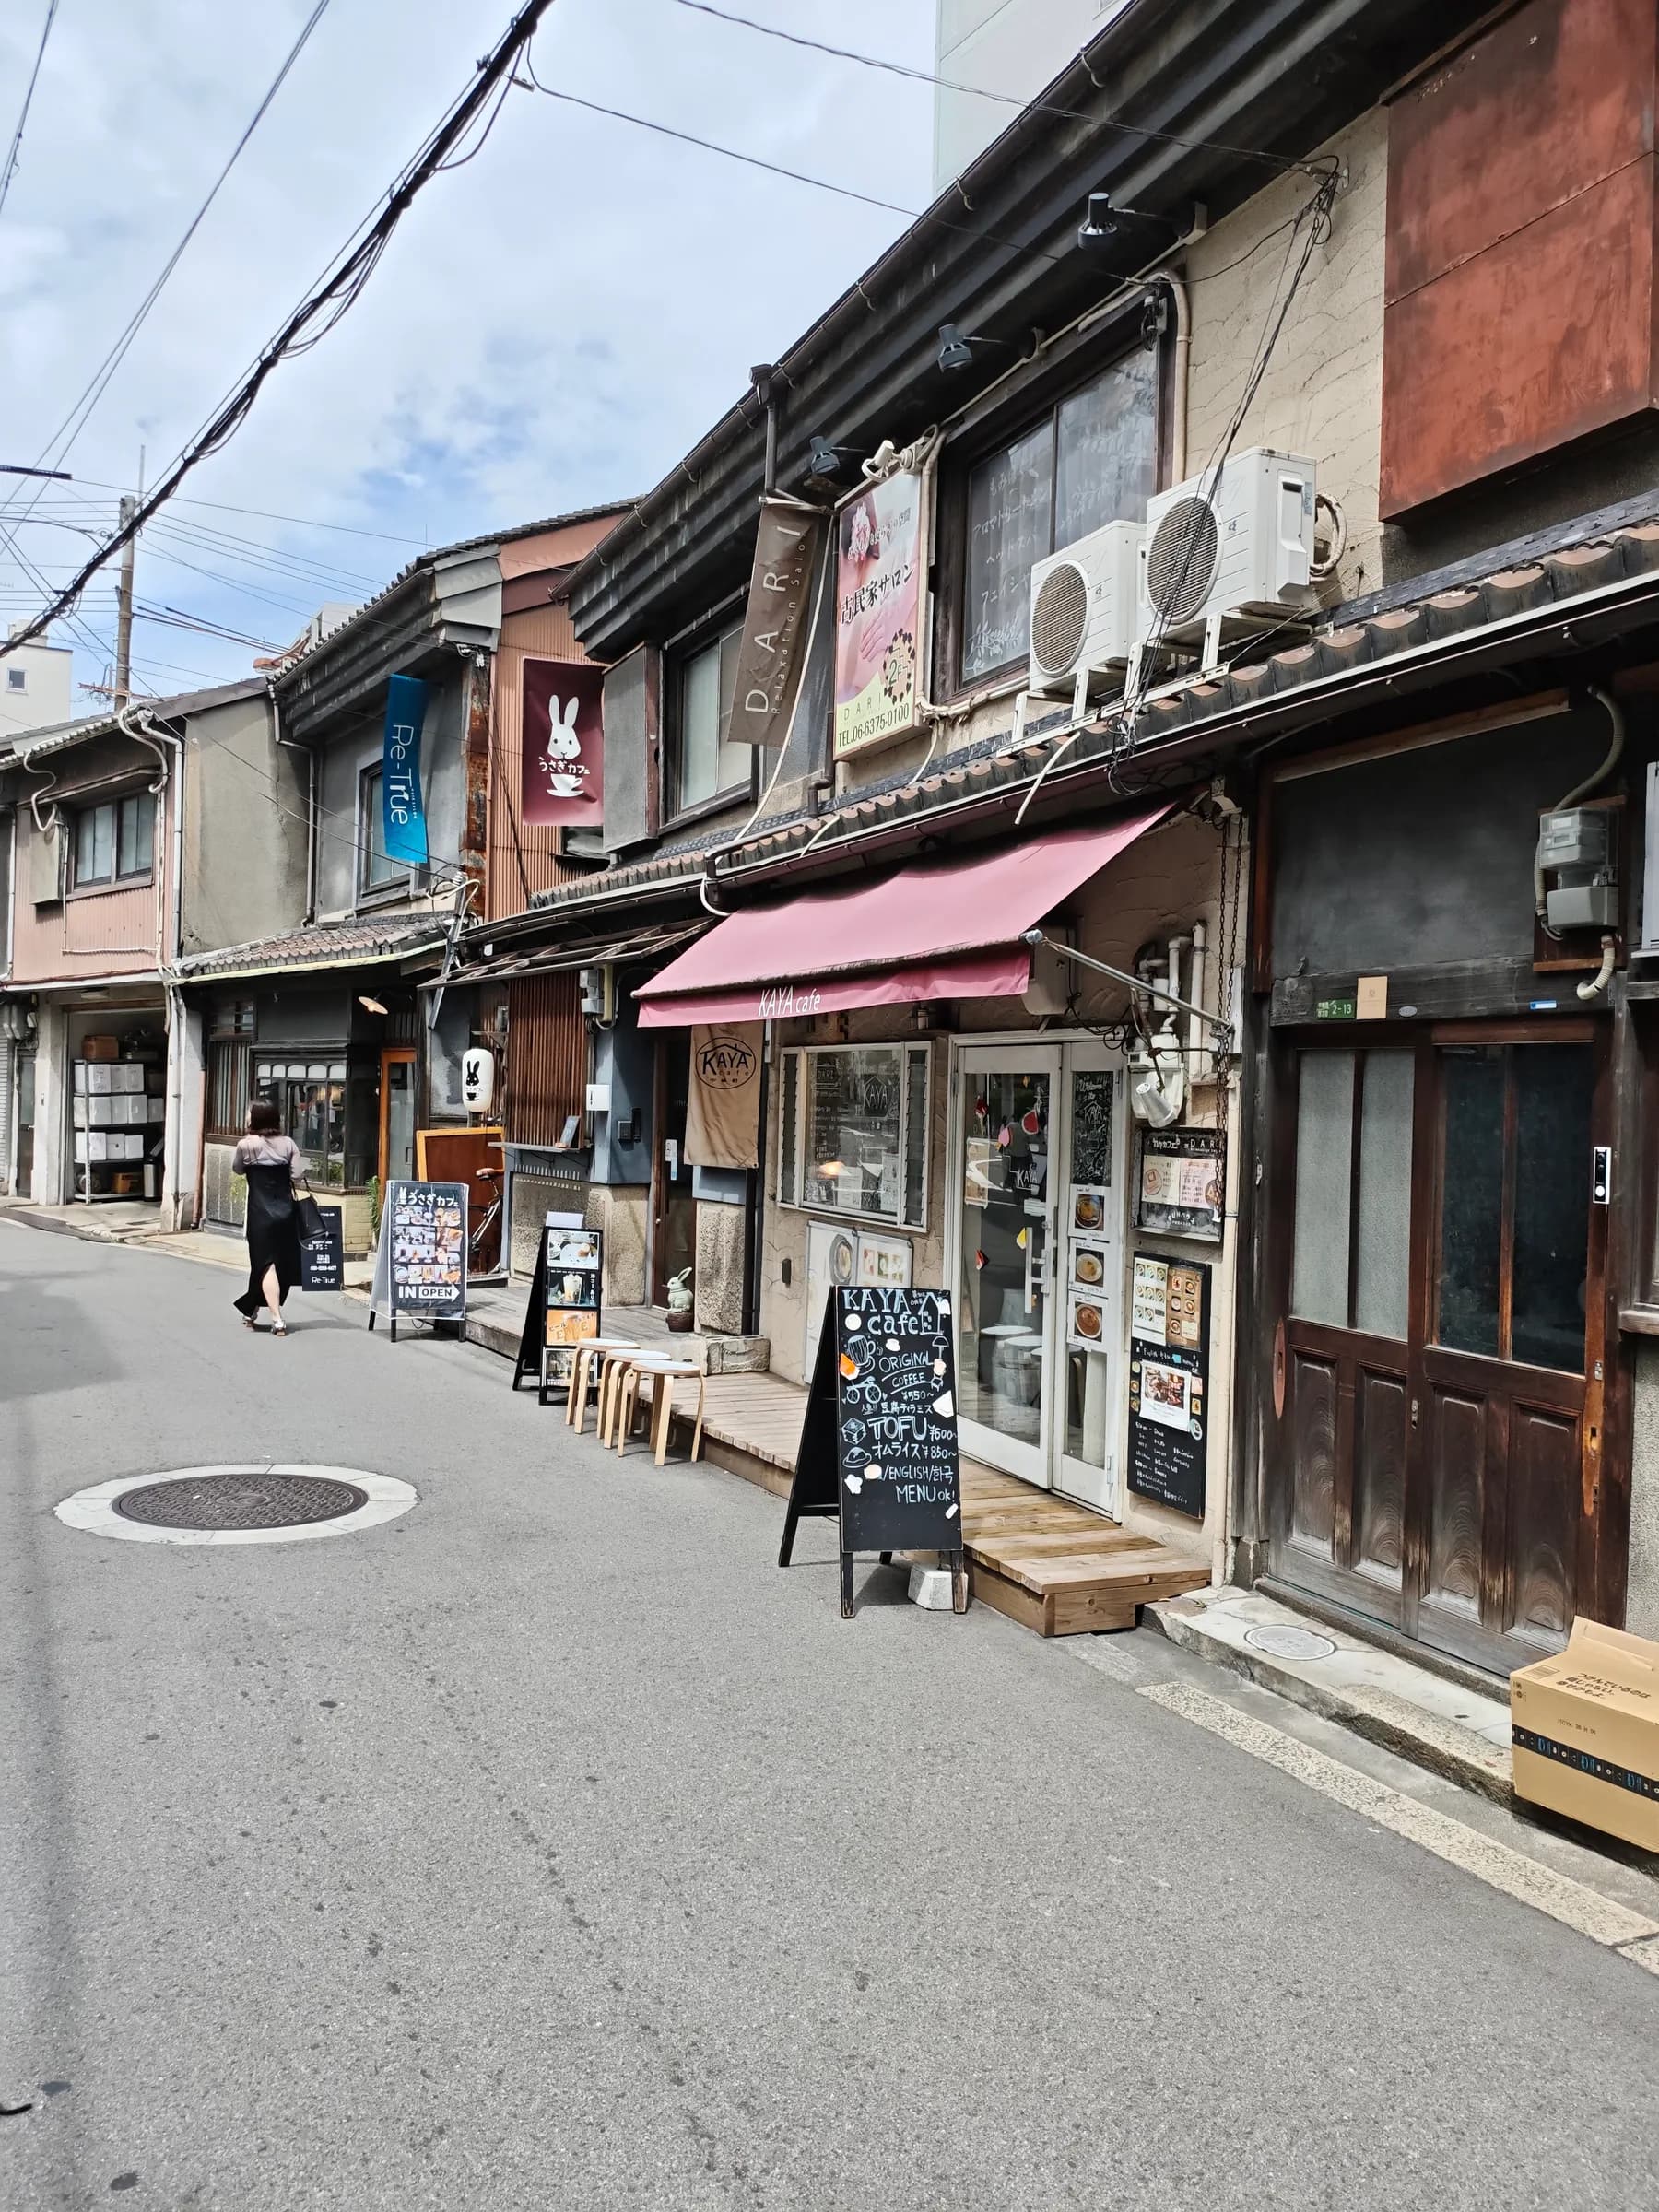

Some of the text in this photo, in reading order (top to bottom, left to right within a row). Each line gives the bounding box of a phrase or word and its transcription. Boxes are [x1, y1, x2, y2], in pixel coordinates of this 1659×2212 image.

[791, 532, 807, 586] Salo
[841, 564, 914, 624] 古民家サロン
[390, 724, 415, 825] Re-True
[538, 756, 591, 774] うさぎカフェ
[759, 985, 821, 1018] KAYA cafe
[703, 1051, 748, 1076] KAYA
[863, 1084, 888, 1109] KAYA
[408, 1189, 459, 1207] うさぎカフェ
[398, 1286, 453, 1299] IN OPEN
[842, 1289, 912, 1314] KAYA
[867, 1313, 920, 1335] cafe
[891, 1372, 925, 1388] COFFEE
[866, 1415, 927, 1441] TOFU
[872, 1441, 922, 1460] オムライス
[895, 1483, 936, 1504] MENU
